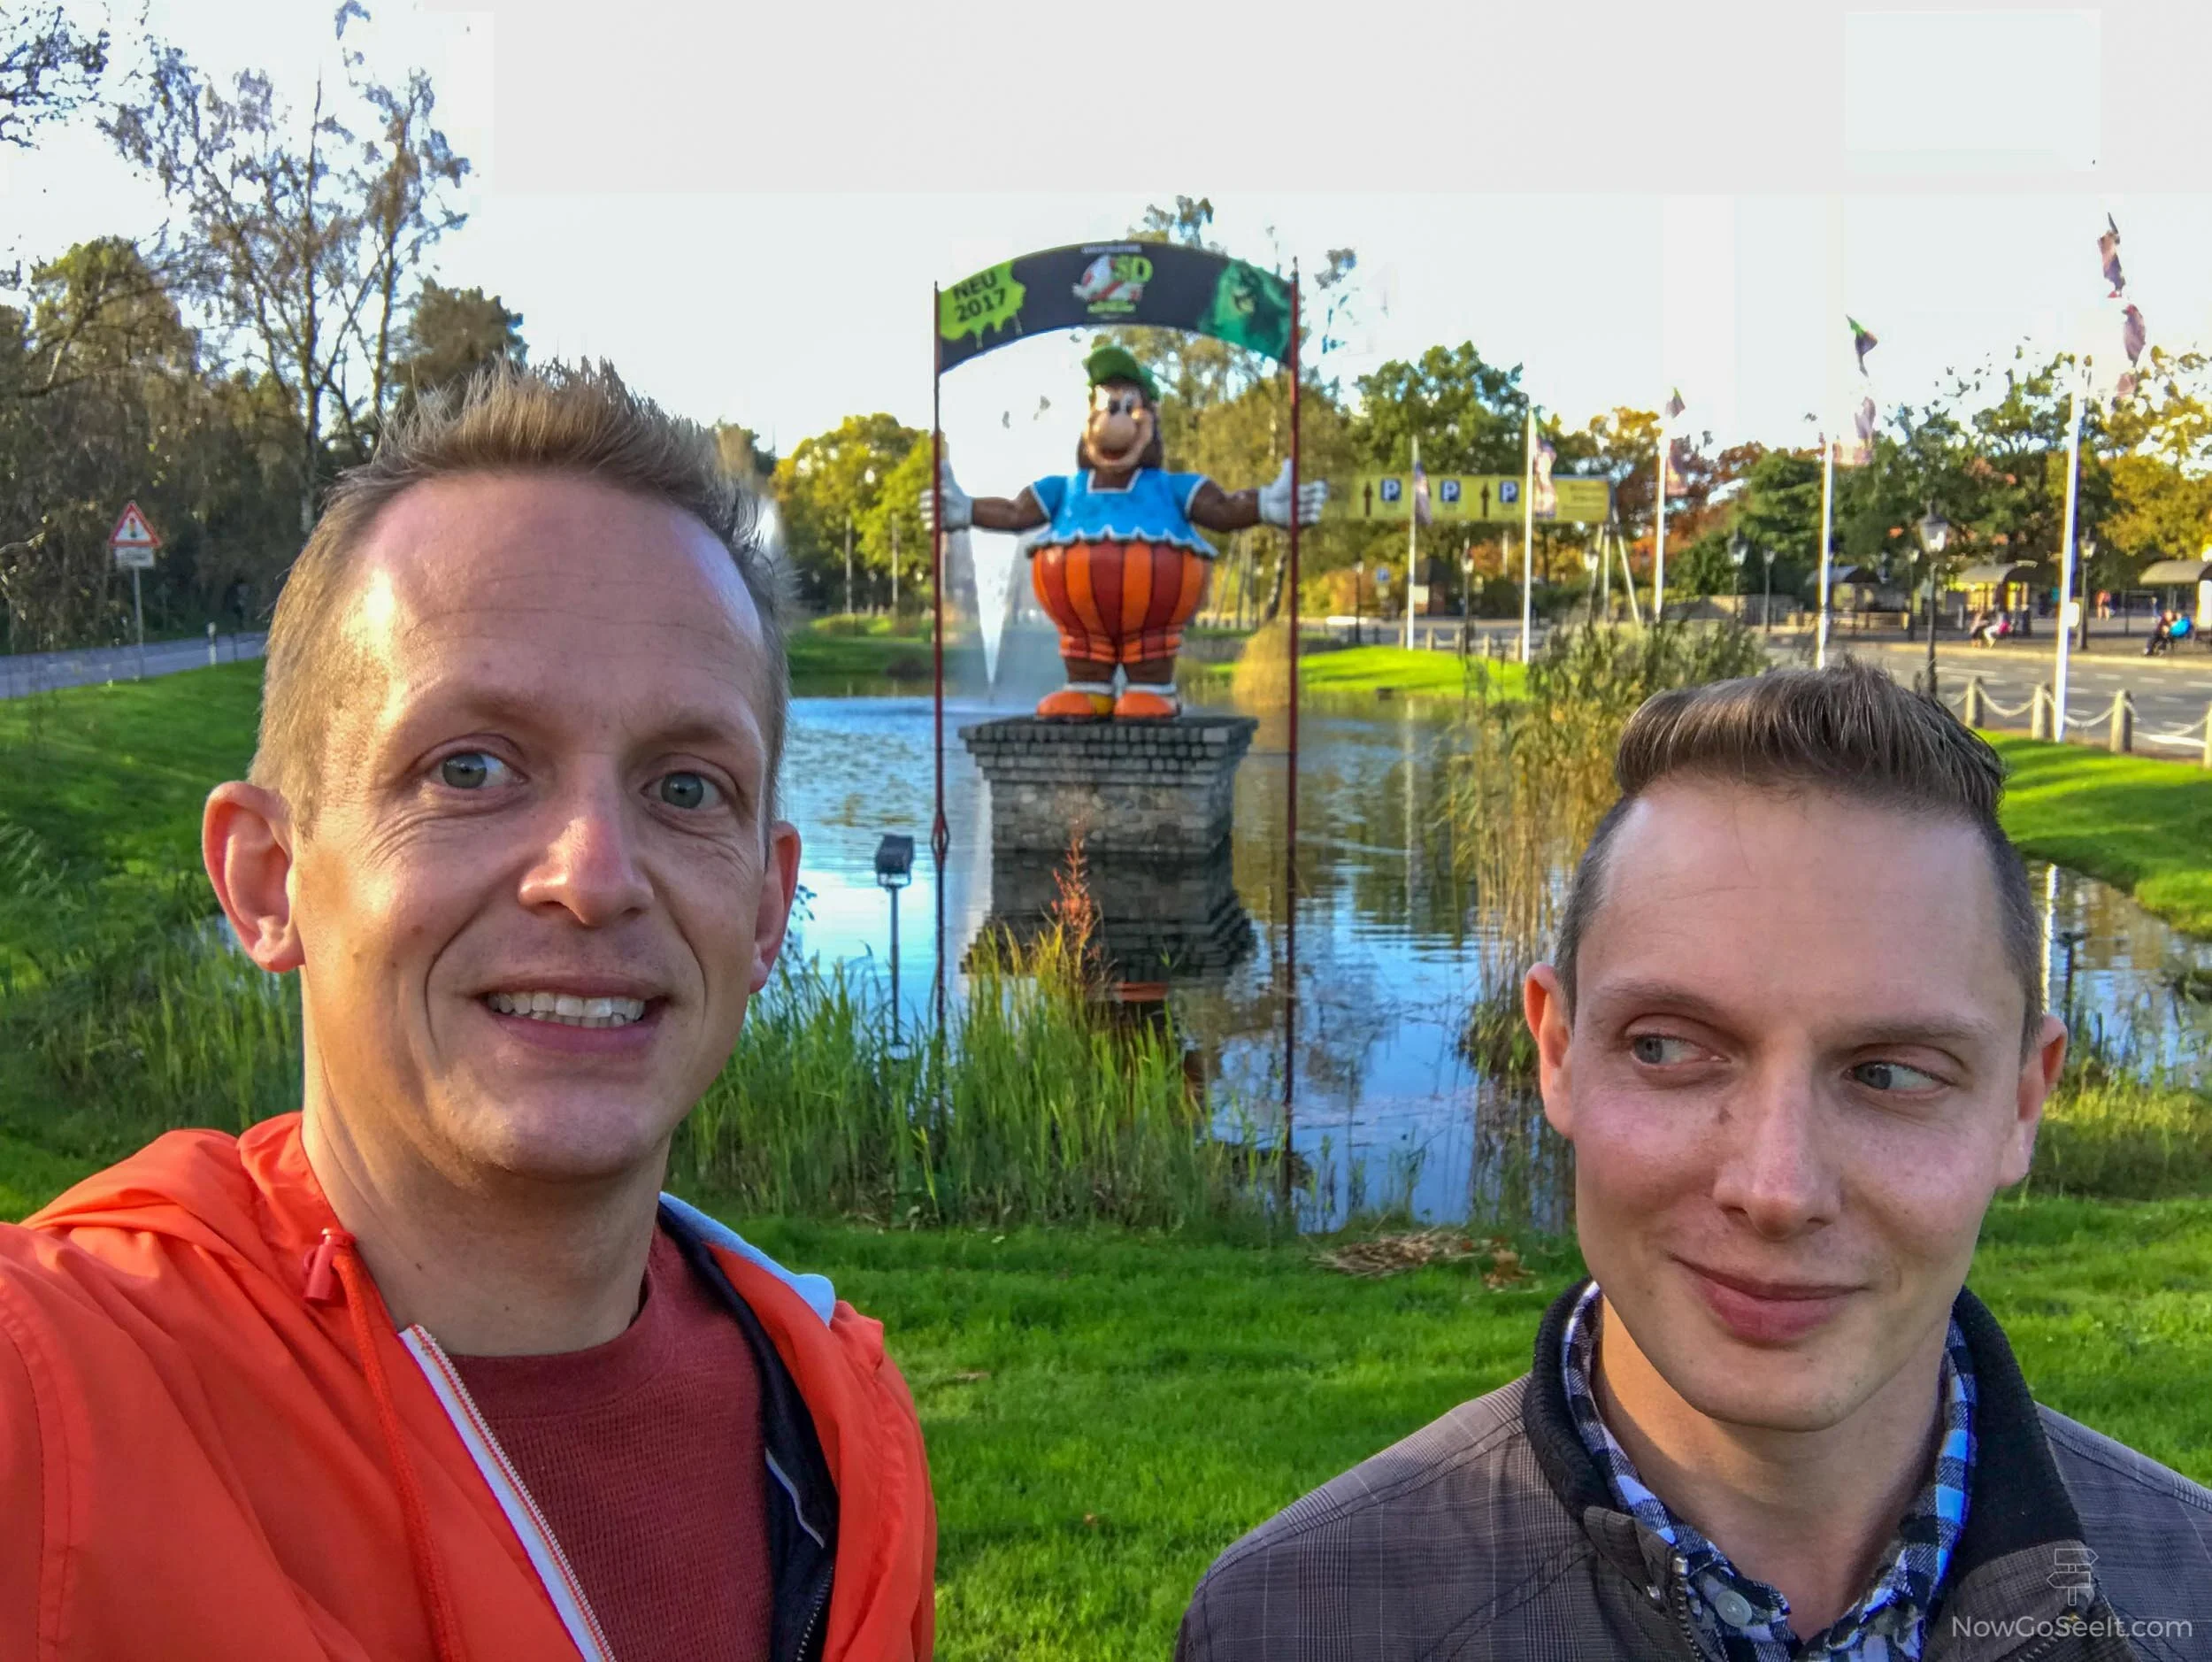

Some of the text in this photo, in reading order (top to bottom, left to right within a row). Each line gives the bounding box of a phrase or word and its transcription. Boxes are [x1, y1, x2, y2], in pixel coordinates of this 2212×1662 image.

[952, 269, 997, 300] NEU
[955, 288, 1006, 323] 2017
[1383, 480, 1399, 502] P
[1443, 481, 1459, 502] P
[1502, 481, 1517, 502] P
